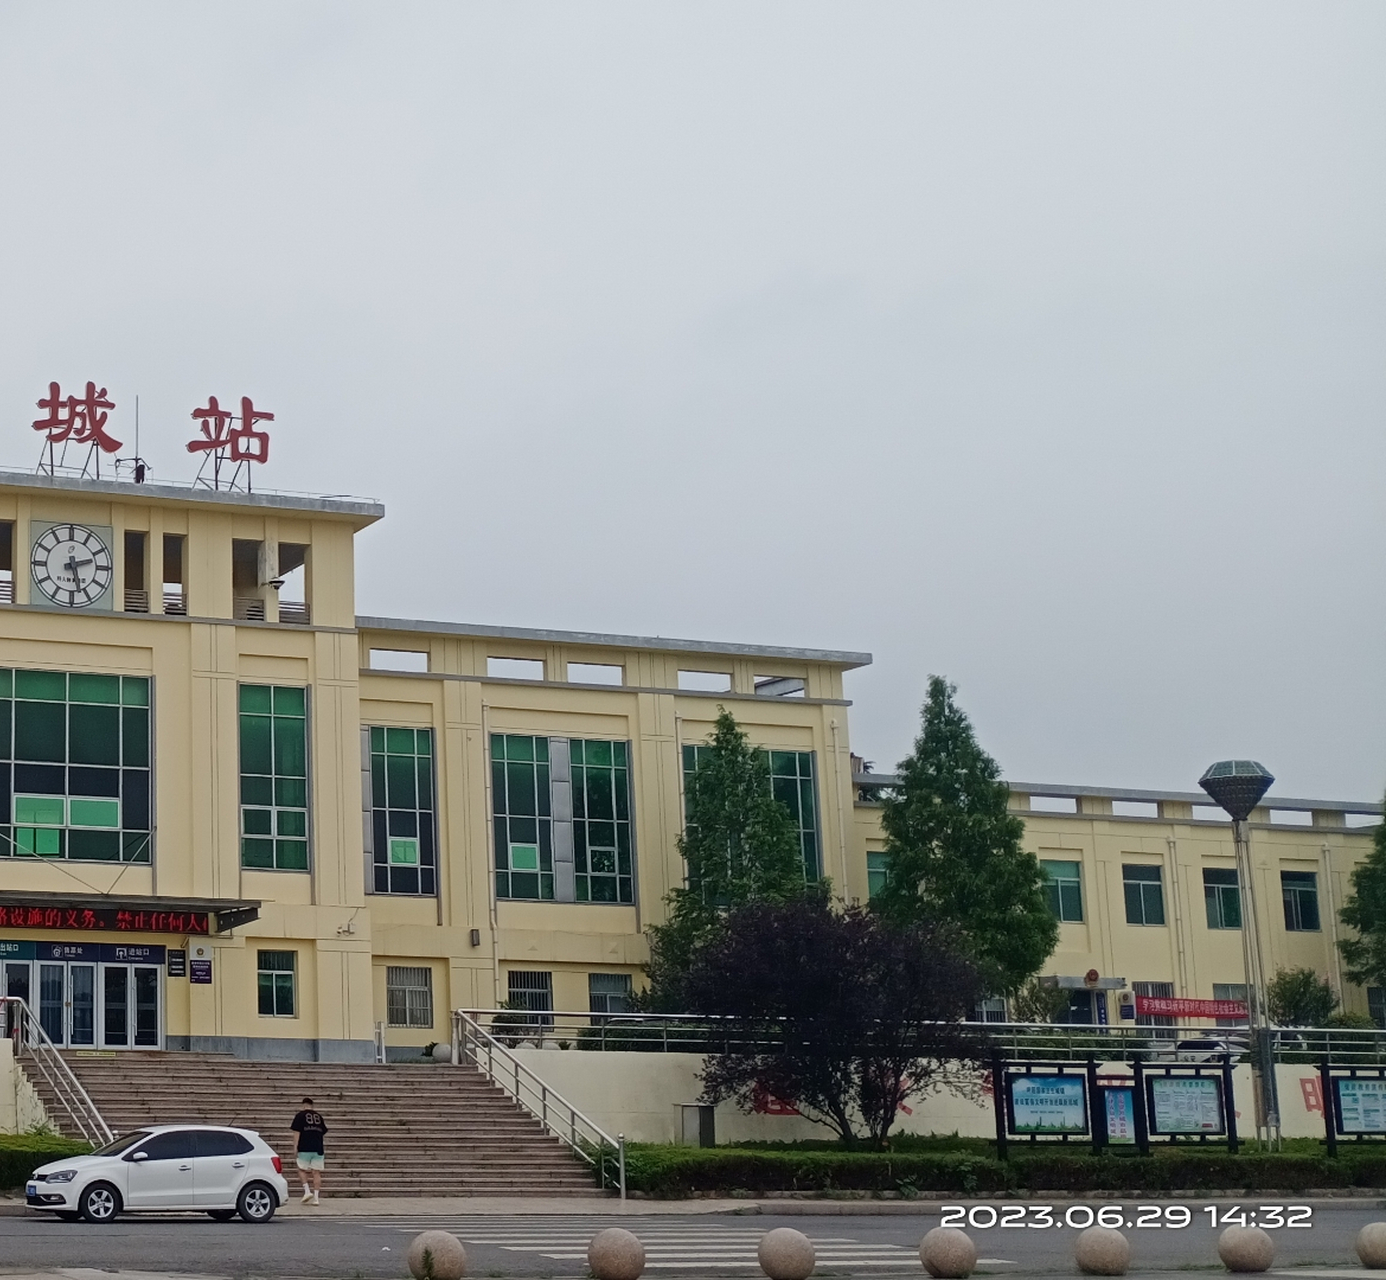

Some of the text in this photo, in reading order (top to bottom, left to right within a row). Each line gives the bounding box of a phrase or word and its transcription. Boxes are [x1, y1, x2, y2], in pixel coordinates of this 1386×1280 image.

[0, 943, 19, 952] 出站口
[128, 947, 150, 956] 进站口
